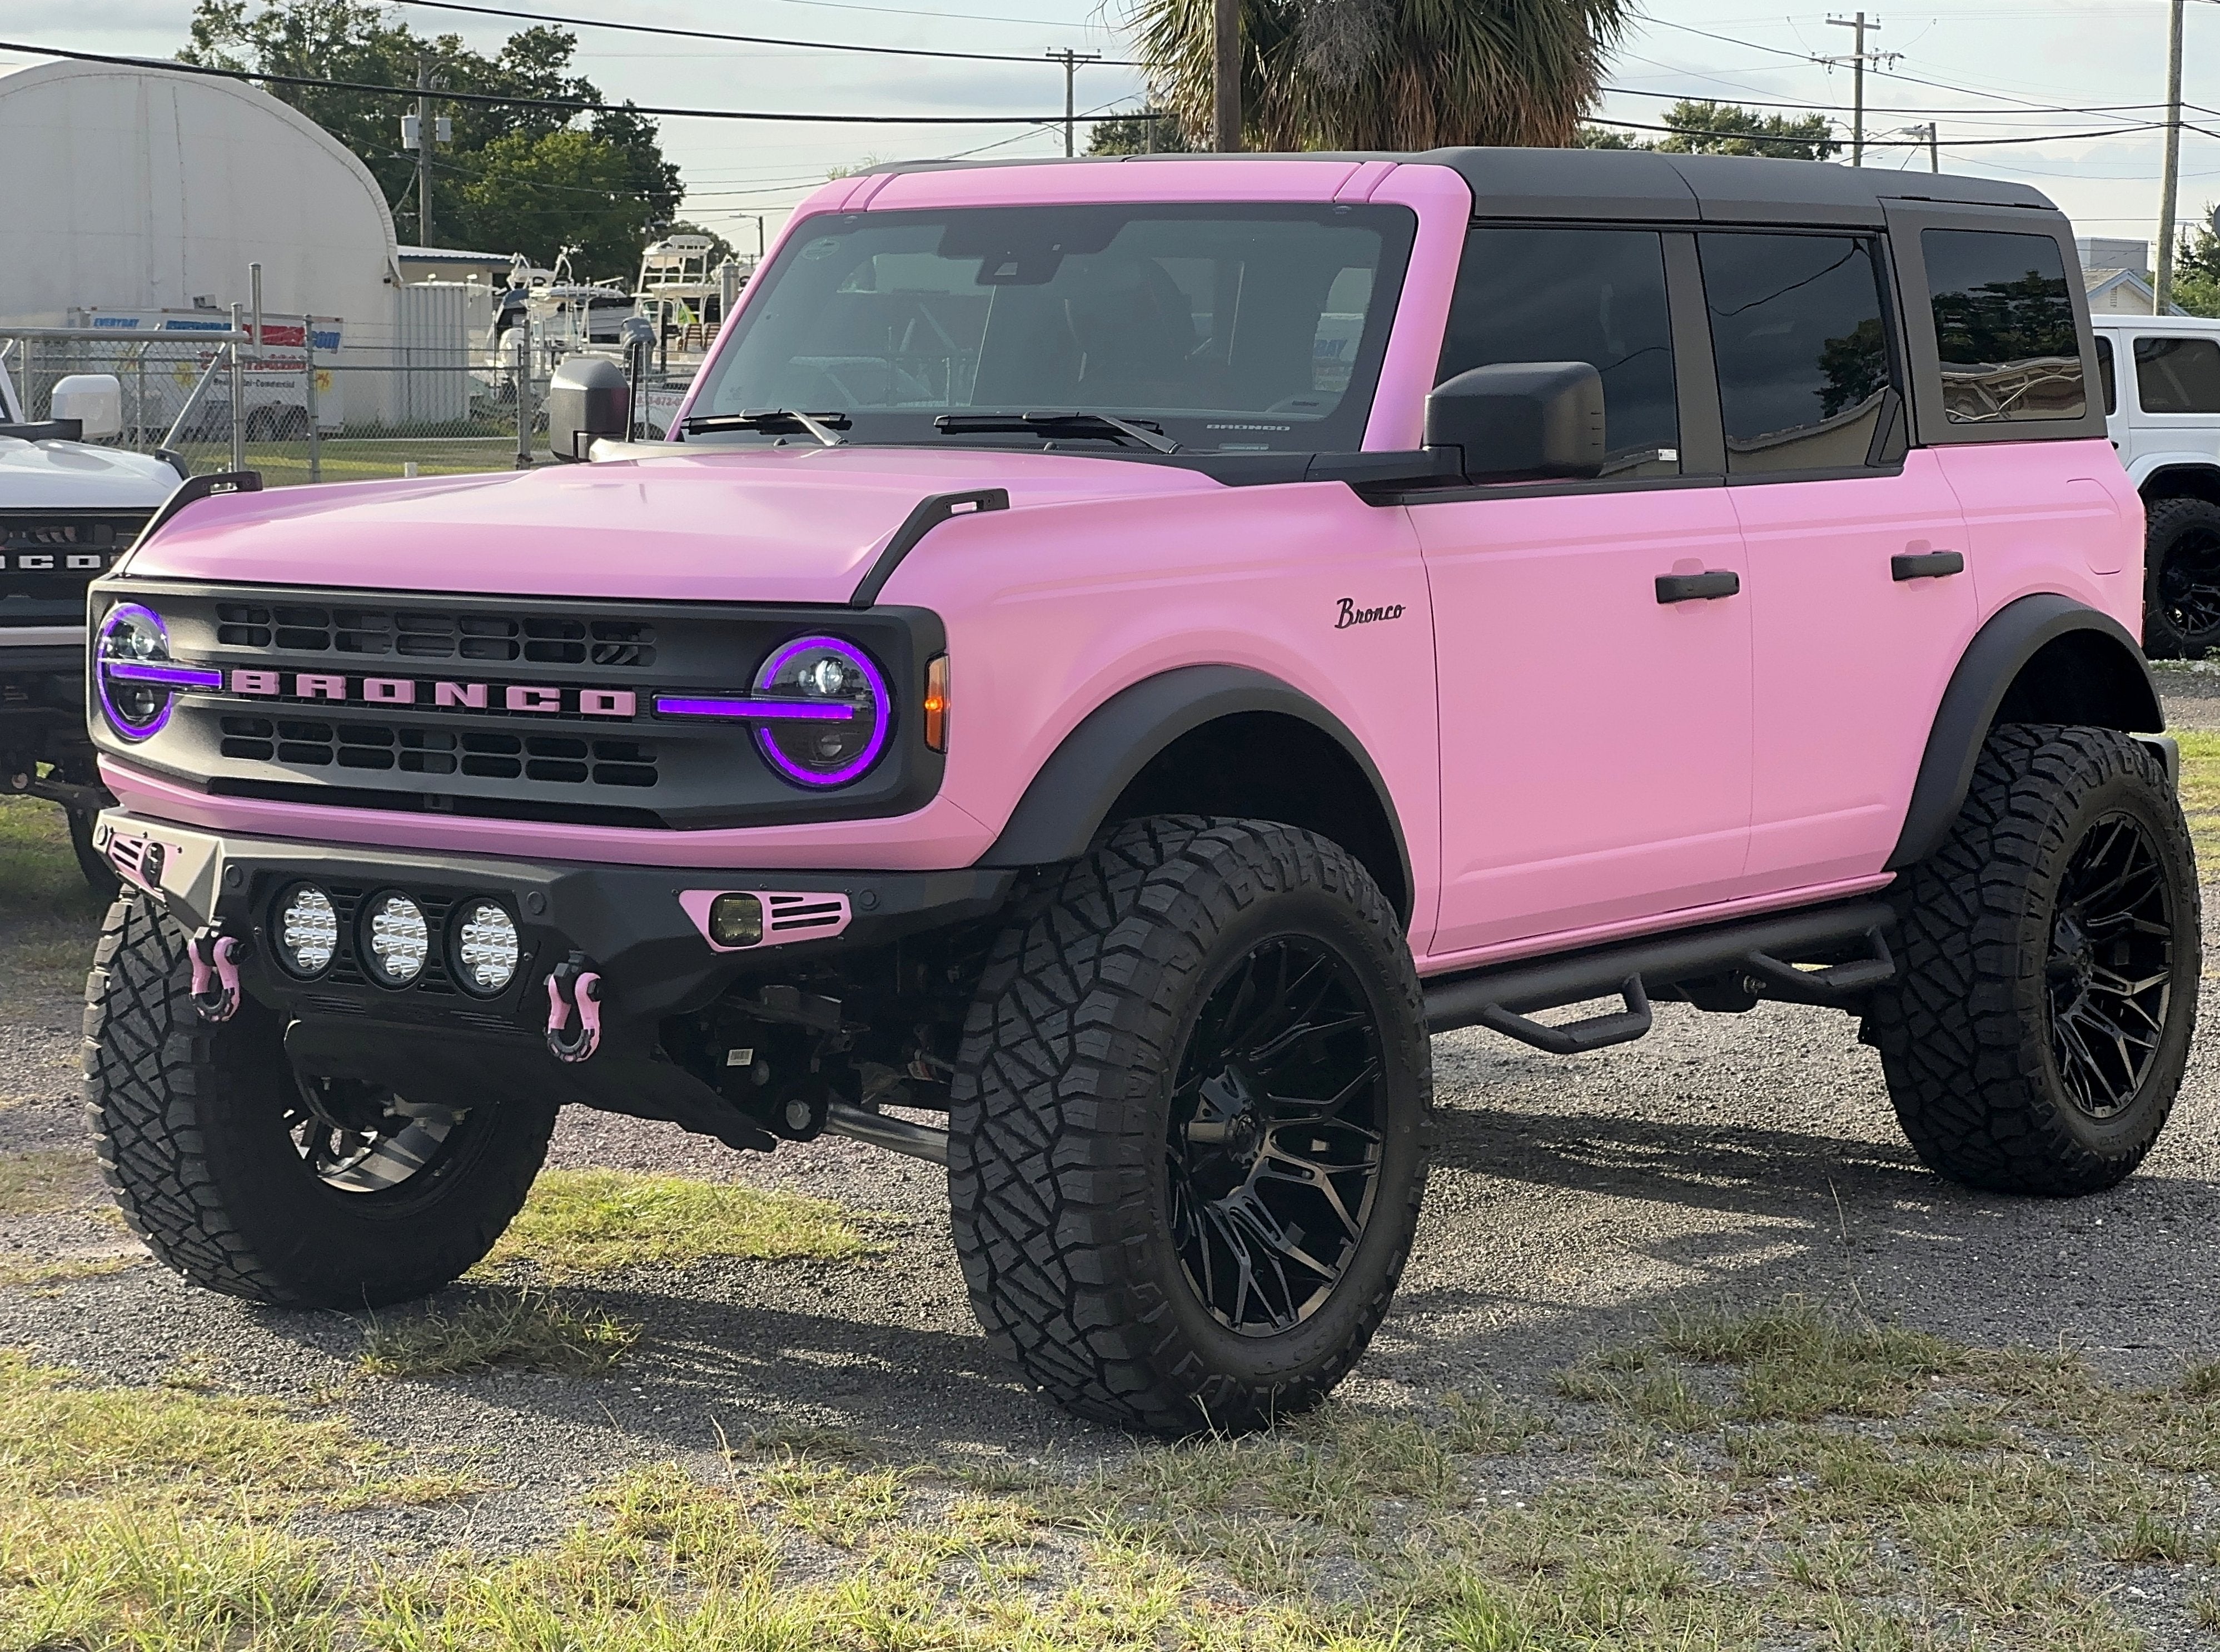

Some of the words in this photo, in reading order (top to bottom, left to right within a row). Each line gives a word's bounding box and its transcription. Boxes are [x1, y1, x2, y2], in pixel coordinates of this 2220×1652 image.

[0, 555, 101, 569] CO
[1334, 598, 1406, 629] Bronco
[231, 669, 636, 716] BRONCO
